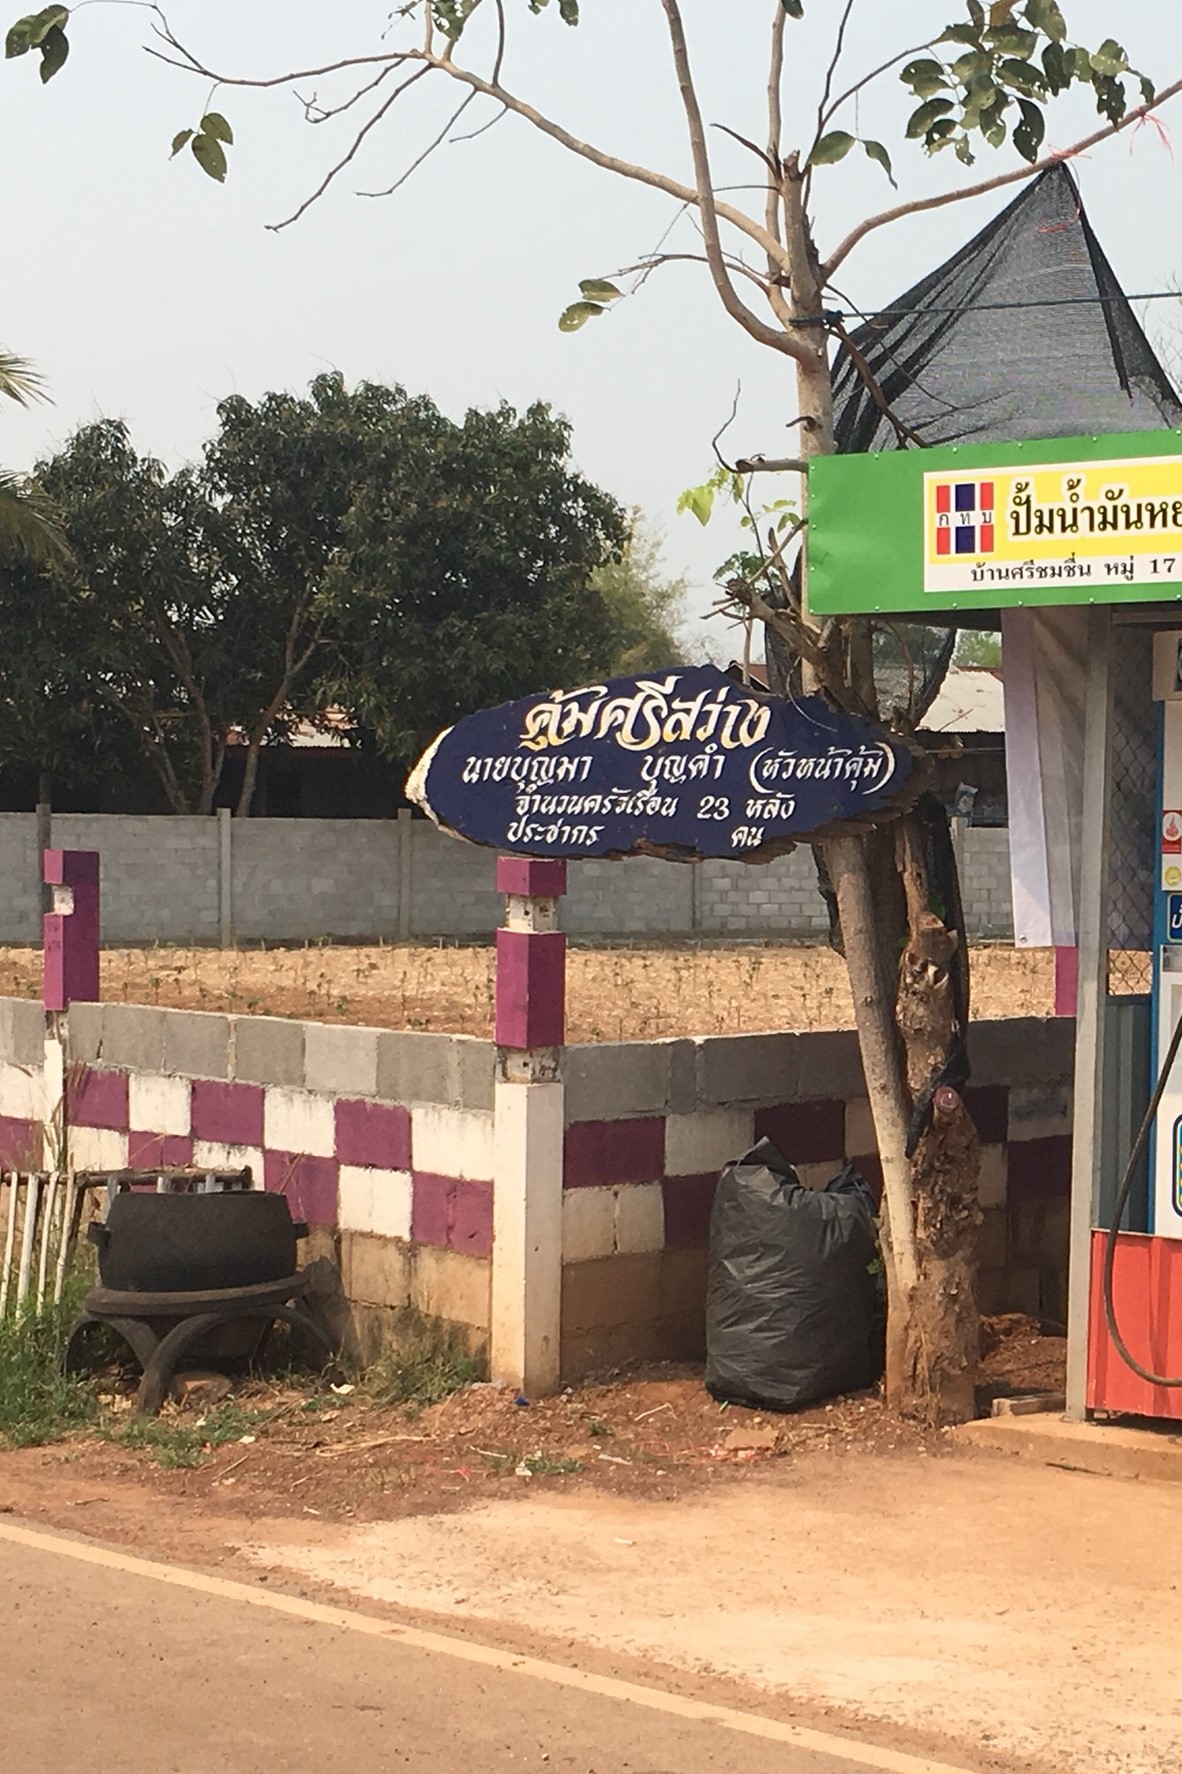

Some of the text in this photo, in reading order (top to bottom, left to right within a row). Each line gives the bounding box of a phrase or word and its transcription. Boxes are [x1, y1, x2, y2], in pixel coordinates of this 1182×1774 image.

[938, 510, 993, 526] ก ท บ
[970, 552, 1092, 582] บ้านศรีชมชื่น
[1103, 555, 1135, 581] หมู่
[1150, 557, 1176, 574] 17
[518, 675, 772, 752] คุ้มศรีสว่าง
[462, 741, 896, 795] นายบุญมา บุญคำ (หัวหน้าคุ้ม)
[515, 783, 797, 821] จำนวนครัวเรือน 23 หลัง
[507, 814, 765, 848] ประชากร คน
